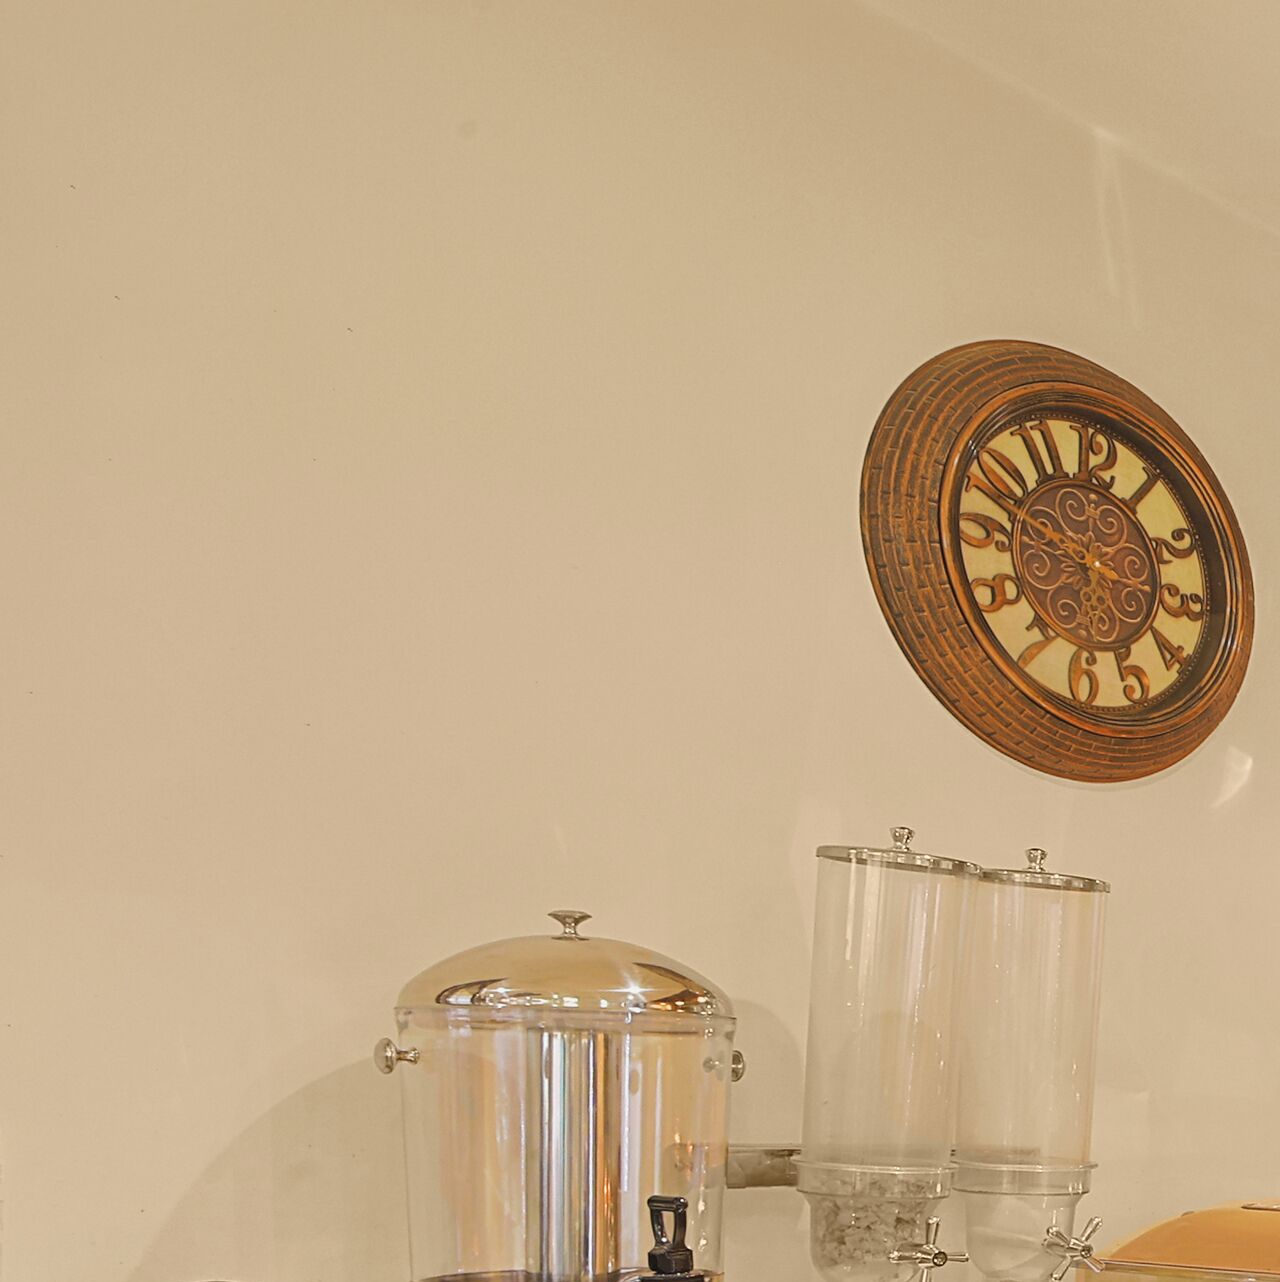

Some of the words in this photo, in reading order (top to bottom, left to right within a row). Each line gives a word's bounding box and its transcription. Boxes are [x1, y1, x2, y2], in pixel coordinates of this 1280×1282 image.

[1010, 419, 1069, 483] 11
[1069, 423, 1117, 488] 12
[965, 448, 1028, 519] 10
[1120, 465, 1162, 515] 1
[959, 512, 1012, 552] 9
[1152, 528, 1196, 567] 2
[970, 573, 1022, 613] 8
[1162, 583, 1203, 621] 3
[1018, 614, 1058, 668] 7
[1151, 628, 1192, 676] 4
[1069, 648, 1099, 705] 6
[1115, 648, 1149, 702] 5
